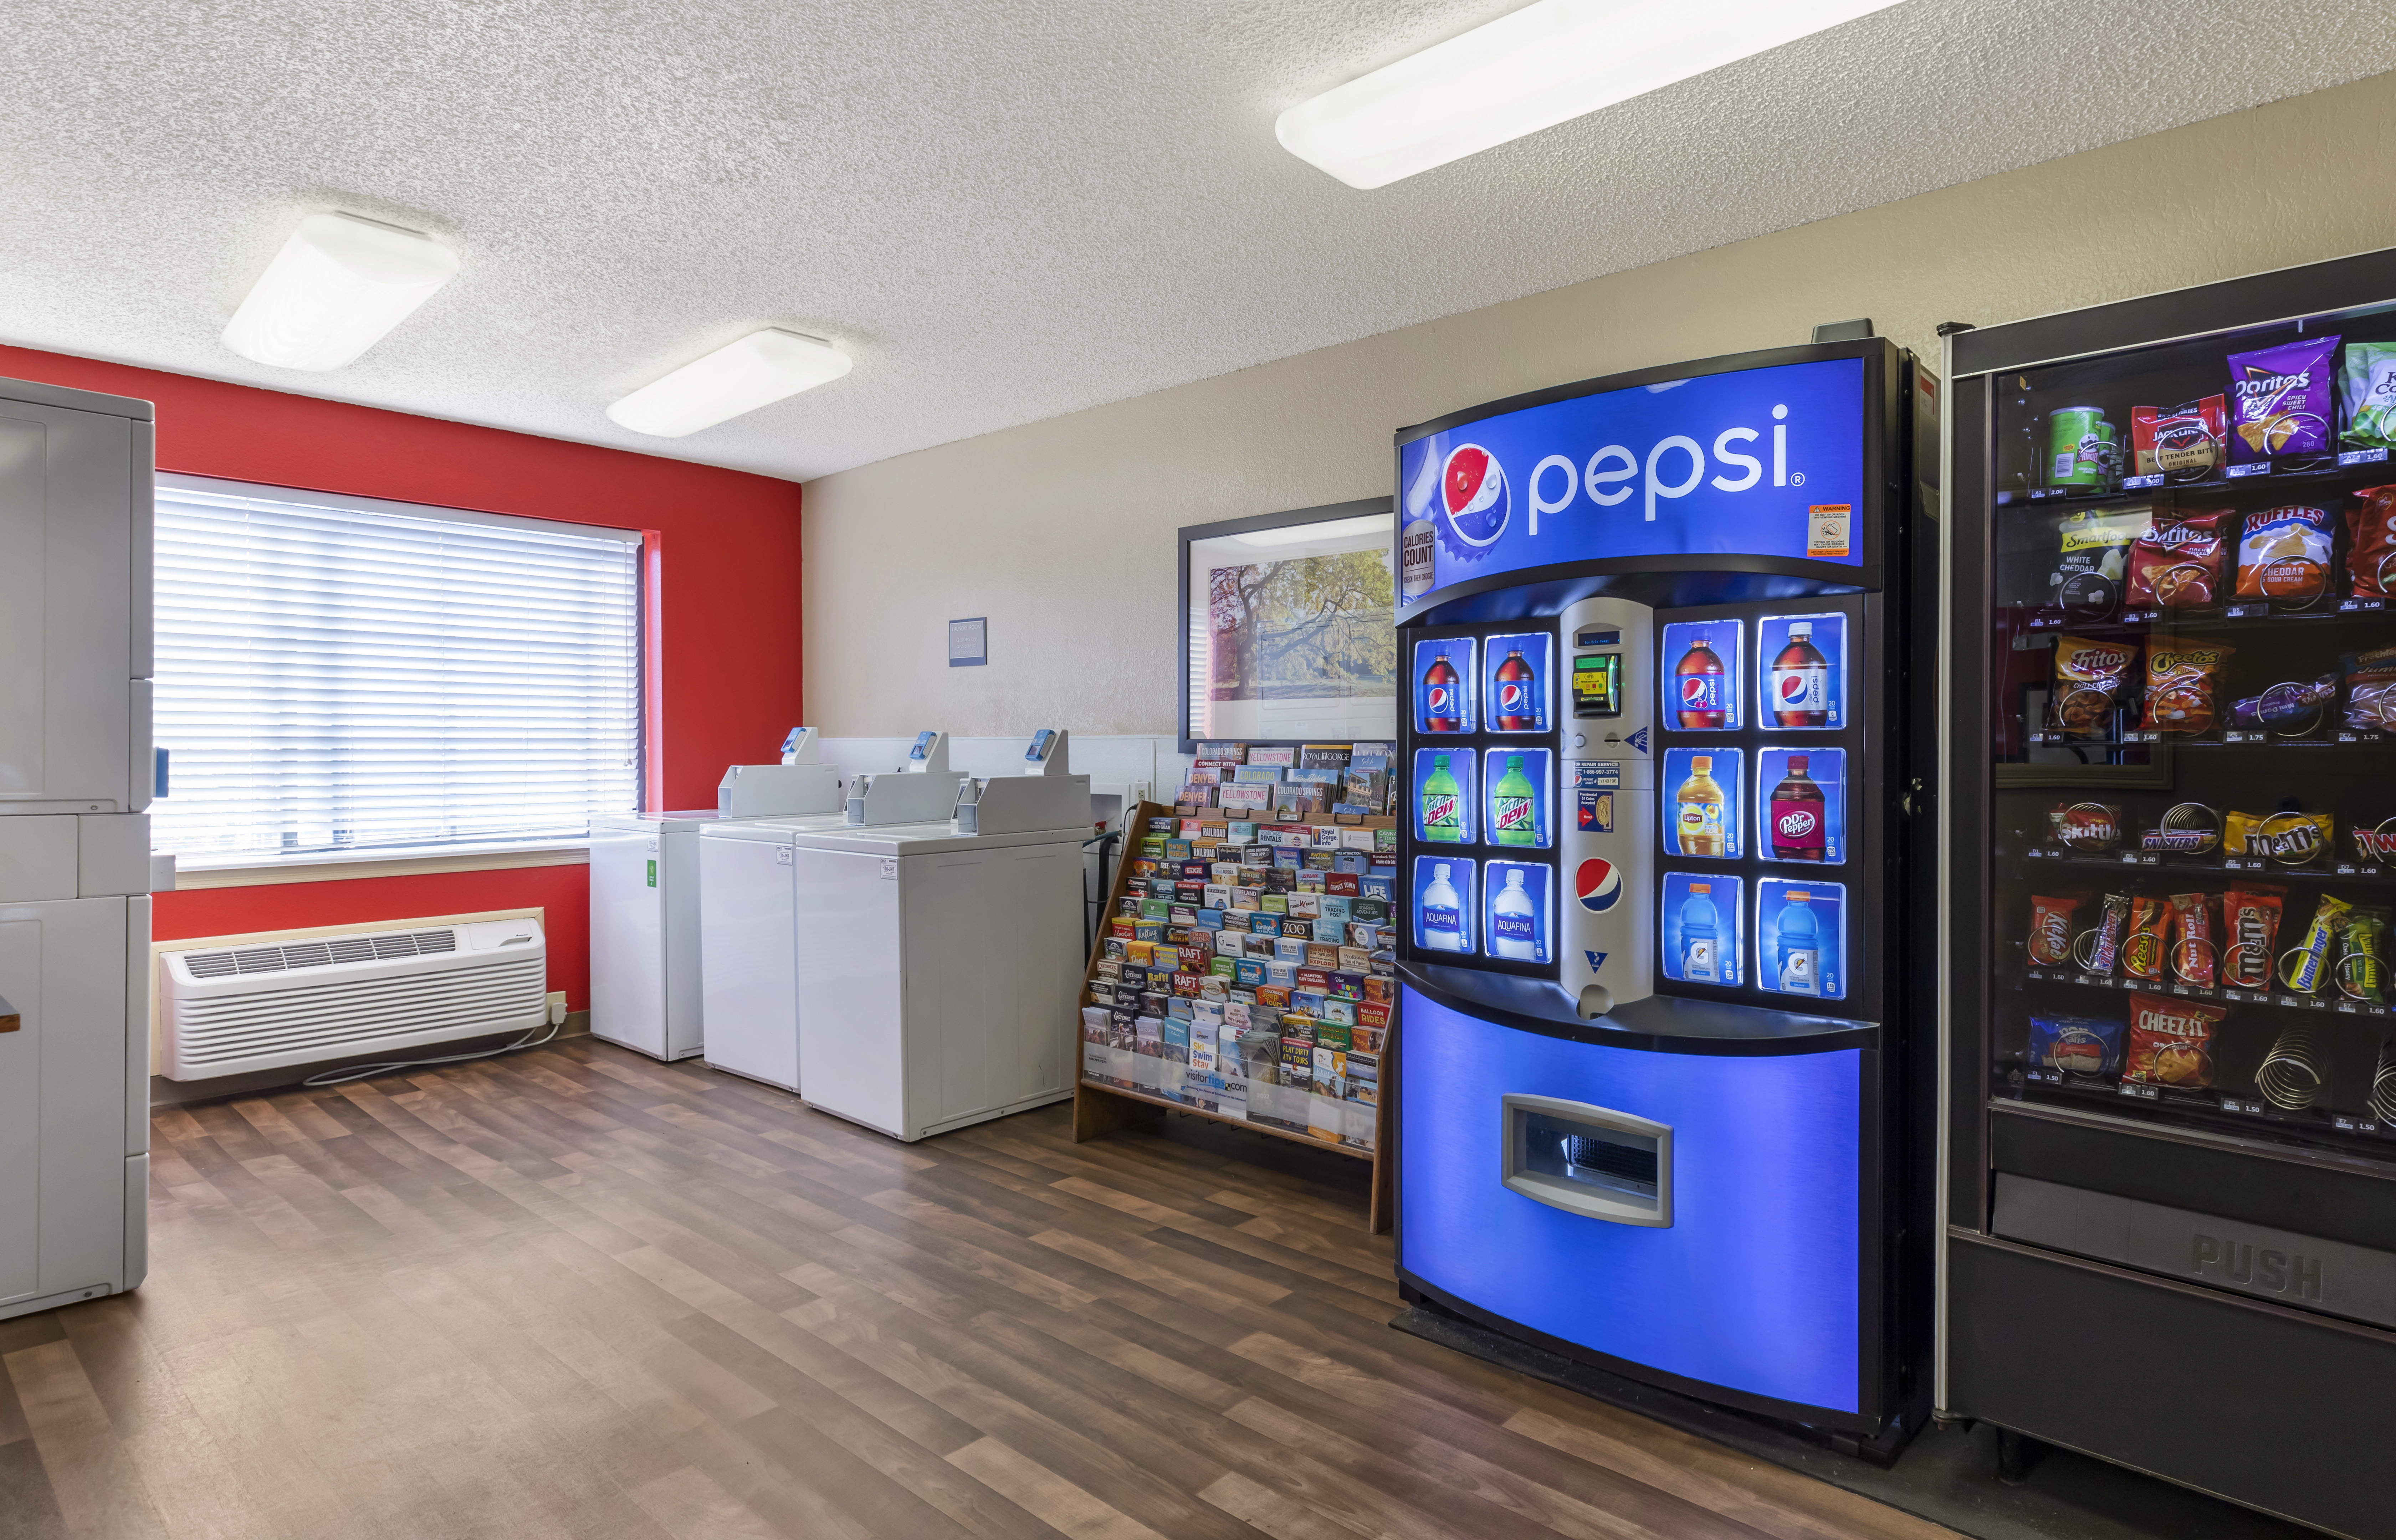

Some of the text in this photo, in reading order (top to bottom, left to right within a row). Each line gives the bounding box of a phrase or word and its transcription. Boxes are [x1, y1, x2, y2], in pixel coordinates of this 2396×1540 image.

[2236, 371, 2310, 397] Doritos
[2165, 451, 2195, 460] TENDER
[2169, 458, 2197, 467] ORIGINAL
[1529, 403, 1788, 536] pepsi
[2245, 505, 2324, 535] RUFFLES
[1404, 531, 1433, 548] CALORIES
[2141, 527, 2213, 543] Doritos
[2060, 564, 2094, 573] CHEDDAR
[2262, 567, 2304, 576] CHEDDAR
[1404, 575, 1413, 584] CHECK
[1422, 572, 1433, 580] CHOOSE
[2070, 648, 2126, 672] Fritos
[2150, 650, 2220, 675] Cheetos
[1202, 748, 1242, 756] COLORADO SPRINGS
[1250, 753, 1291, 762] YELLOWSTONE
[1189, 774, 1217, 784] DENVER
[1240, 771, 1275, 780] COLORADO
[1222, 790, 1265, 800] YELLOWSTONE
[1278, 786, 1323, 796] COLORADO SPRINGS
[1179, 792, 1207, 802] DENVER
[1780, 814, 1813, 834] Dr Pepper
[1203, 827, 1225, 838] RAILROAD
[1193, 848, 1215, 858] RAILROAD
[1233, 888, 1256, 897] LOVELAND
[1363, 884, 1387, 900] LIFE
[1426, 912, 1457, 925] AQUAFINA
[1284, 923, 1305, 935] ZOO
[1498, 920, 1531, 934] AQUAFINA
[1138, 929, 1157, 940] Rafting
[2187, 914, 2198, 968] Nut Roll
[1179, 947, 1200, 960] RAFT
[2130, 925, 2151, 973] Reese's
[2297, 927, 2328, 991] Butterfinger
[1147, 972, 1168, 982] Raft!
[1261, 990, 1278, 1001] Jeep
[1266, 998, 1283, 1008] Tours
[1361, 1015, 1386, 1025] RIDES
[1193, 1050, 1212, 1062] Swim
[1283, 1045, 1309, 1057] PLAY DIRTY
[1293, 1056, 1308, 1065] TOURS
[2193, 1234, 2323, 1303] PUSH
